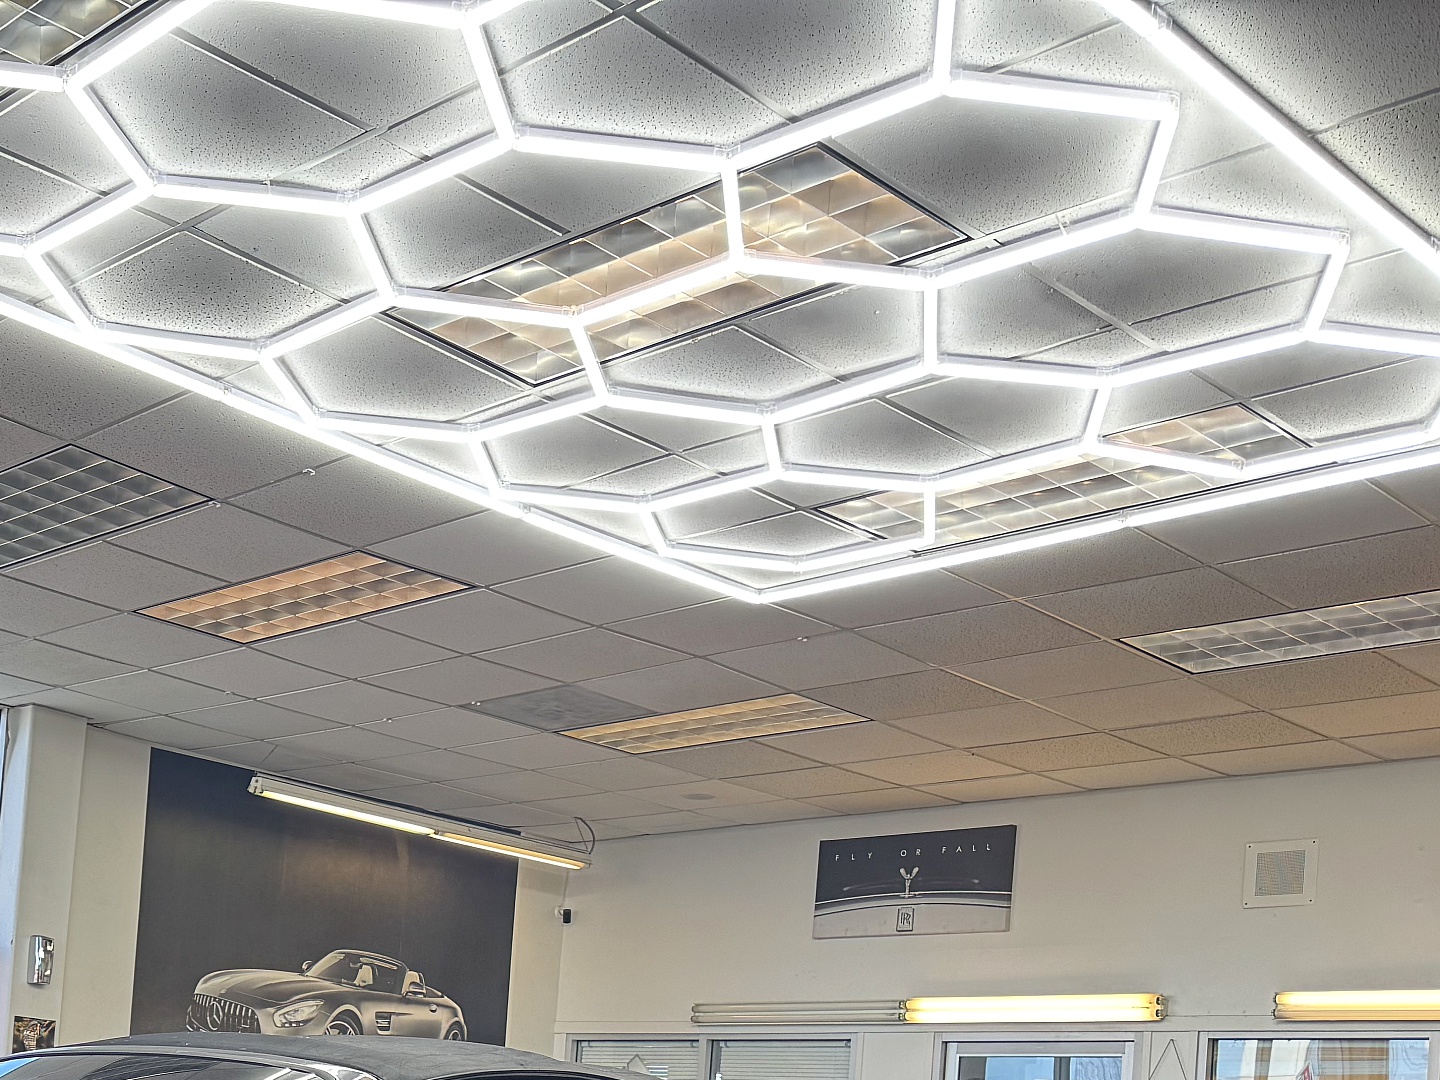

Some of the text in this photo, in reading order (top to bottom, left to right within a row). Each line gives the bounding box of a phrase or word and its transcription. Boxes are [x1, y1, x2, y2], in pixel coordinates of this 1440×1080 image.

[835, 843, 991, 862] FLY OR FALL
